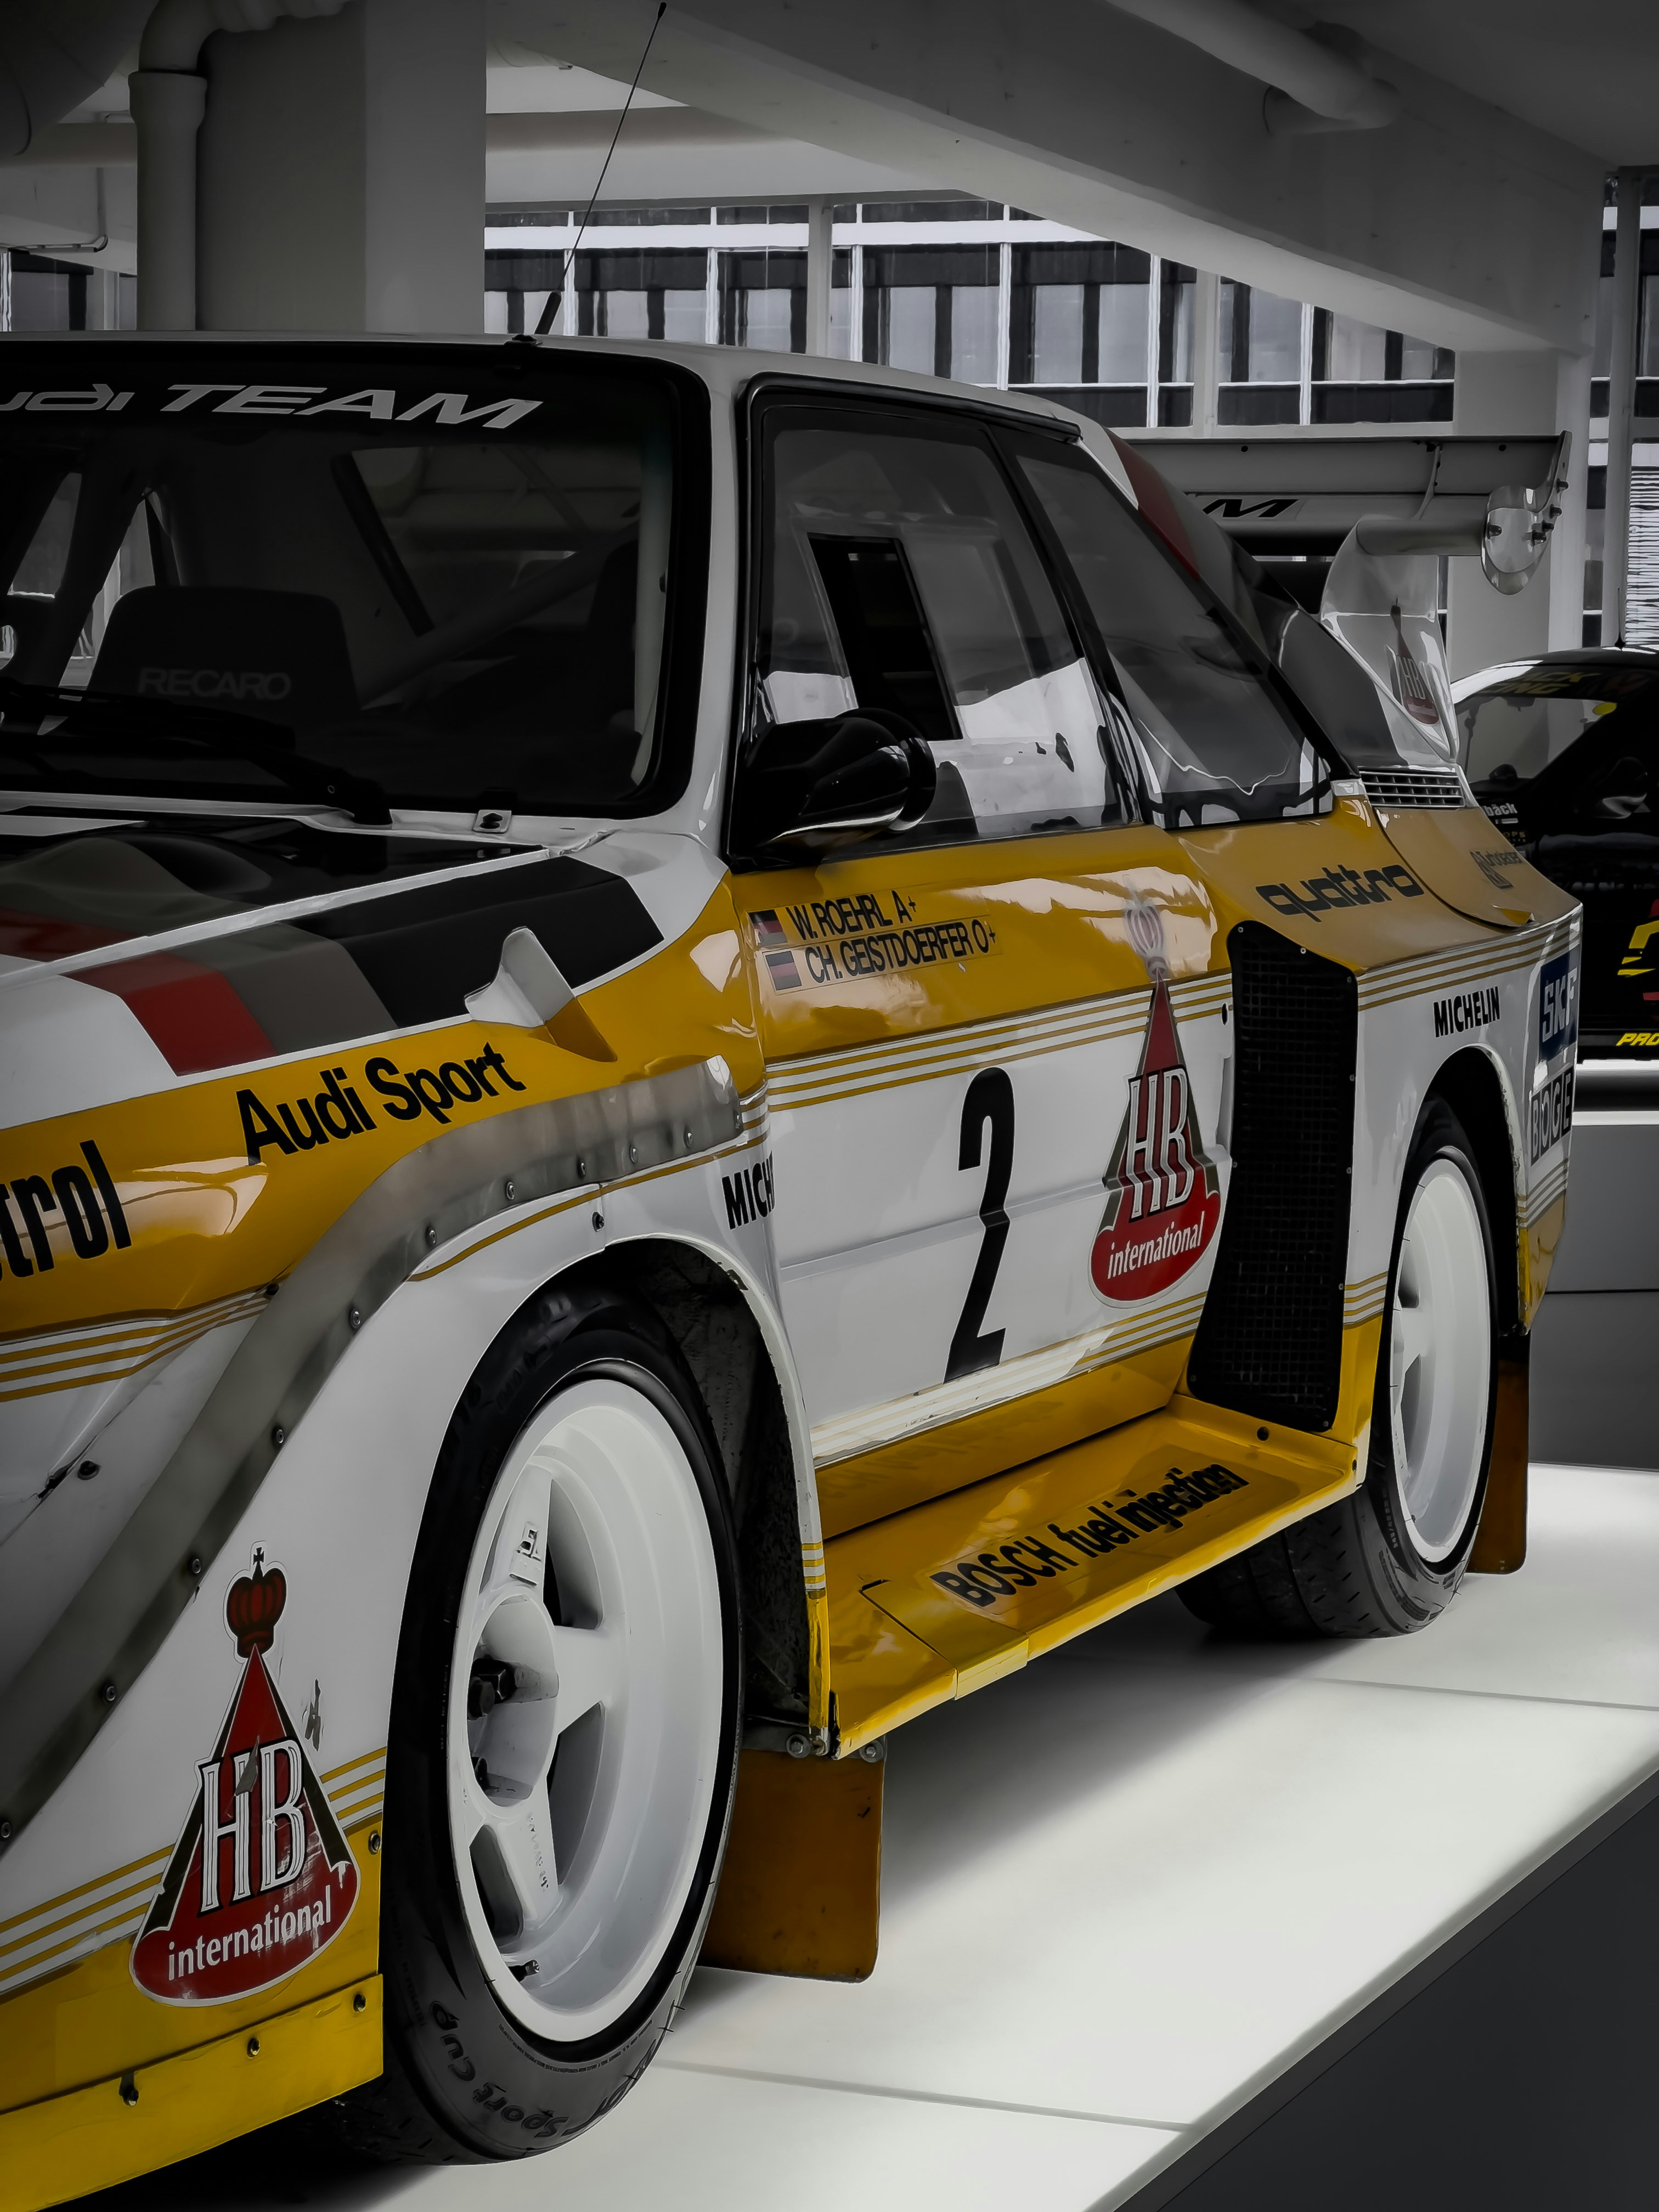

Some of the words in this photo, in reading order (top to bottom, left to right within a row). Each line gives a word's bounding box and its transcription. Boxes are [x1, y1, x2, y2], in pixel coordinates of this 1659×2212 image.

[160, 385, 543, 428] TEAM
[137, 667, 292, 701] RECARO
[1255, 864, 1425, 923] quattro
[1434, 986, 1500, 1038] MICHELIN
[1542, 967, 1578, 1042] SKF
[236, 1066, 377, 1166] Audi
[364, 1042, 527, 1125] Sport
[1126, 1065, 1195, 1223] HB
[1531, 1072, 1572, 1161] BOGE
[0, 1139, 132, 1281] trol
[722, 1150, 775, 1230] MICH
[943, 1066, 1015, 1385] 2
[1107, 1210, 1205, 1280] international
[928, 1536, 1080, 1608] BOSCH
[1047, 1505, 1141, 1559] fuel
[1101, 1463, 1250, 1533] injection
[197, 1735, 307, 1918] HB
[168, 1884, 332, 1982] international
[430, 2000, 476, 2083] Cup
[472, 2083, 569, 2138] Sport
